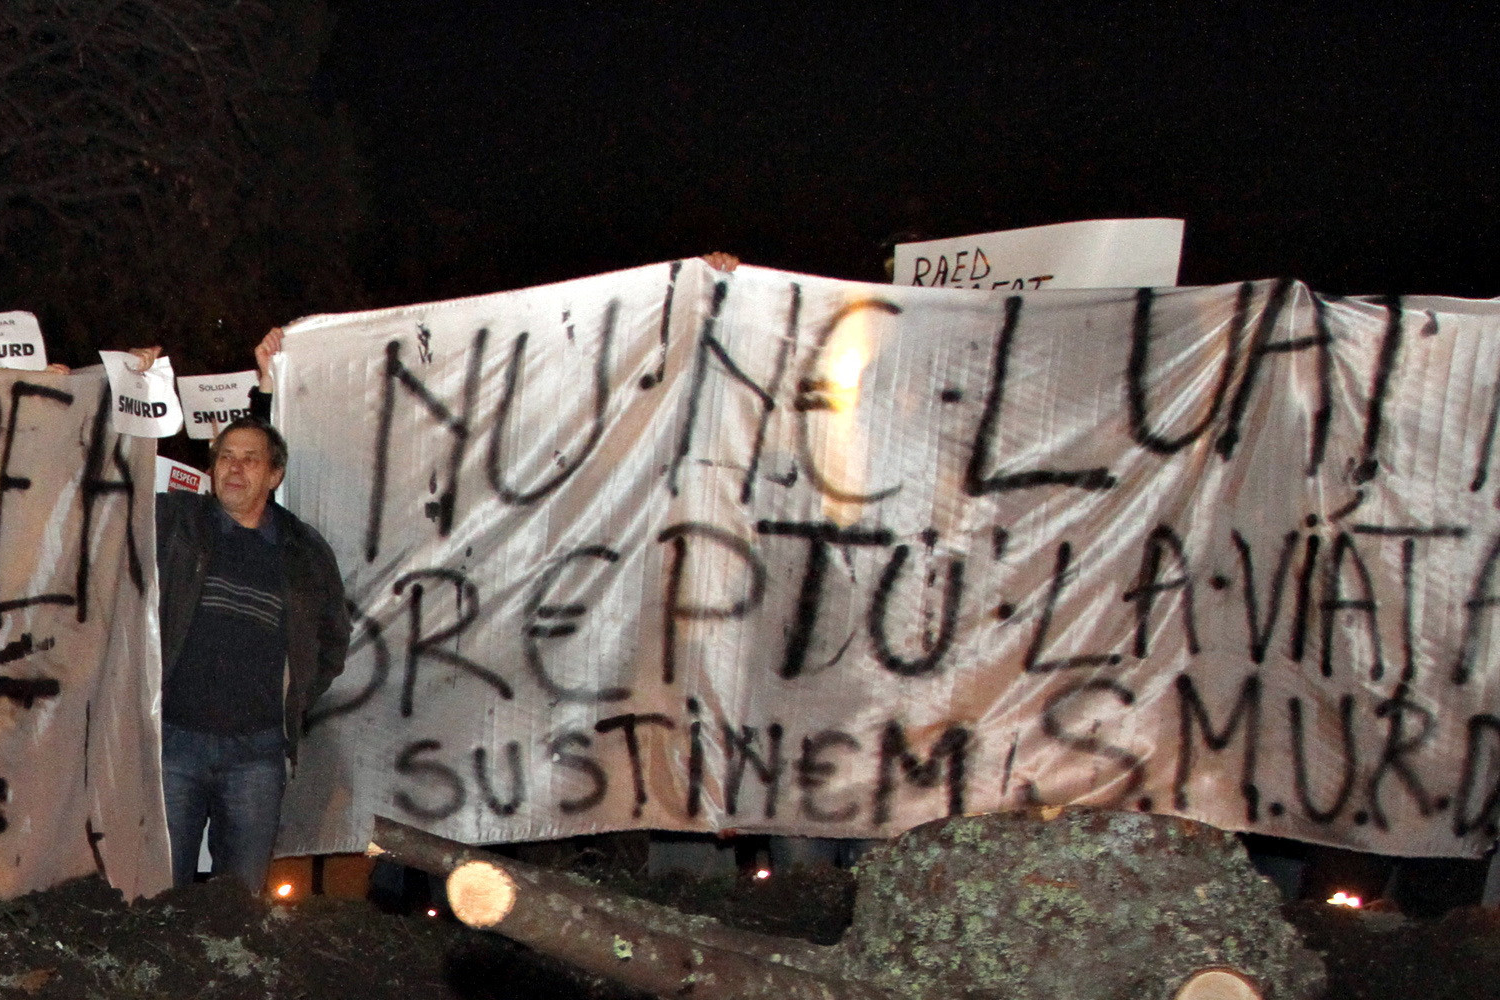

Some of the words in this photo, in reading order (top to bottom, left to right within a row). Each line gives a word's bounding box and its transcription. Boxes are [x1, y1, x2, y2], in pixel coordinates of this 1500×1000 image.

[912, 247, 992, 286] RAED
[198, 382, 238, 392] SOLIDAR
[118, 394, 167, 418] SMURD
